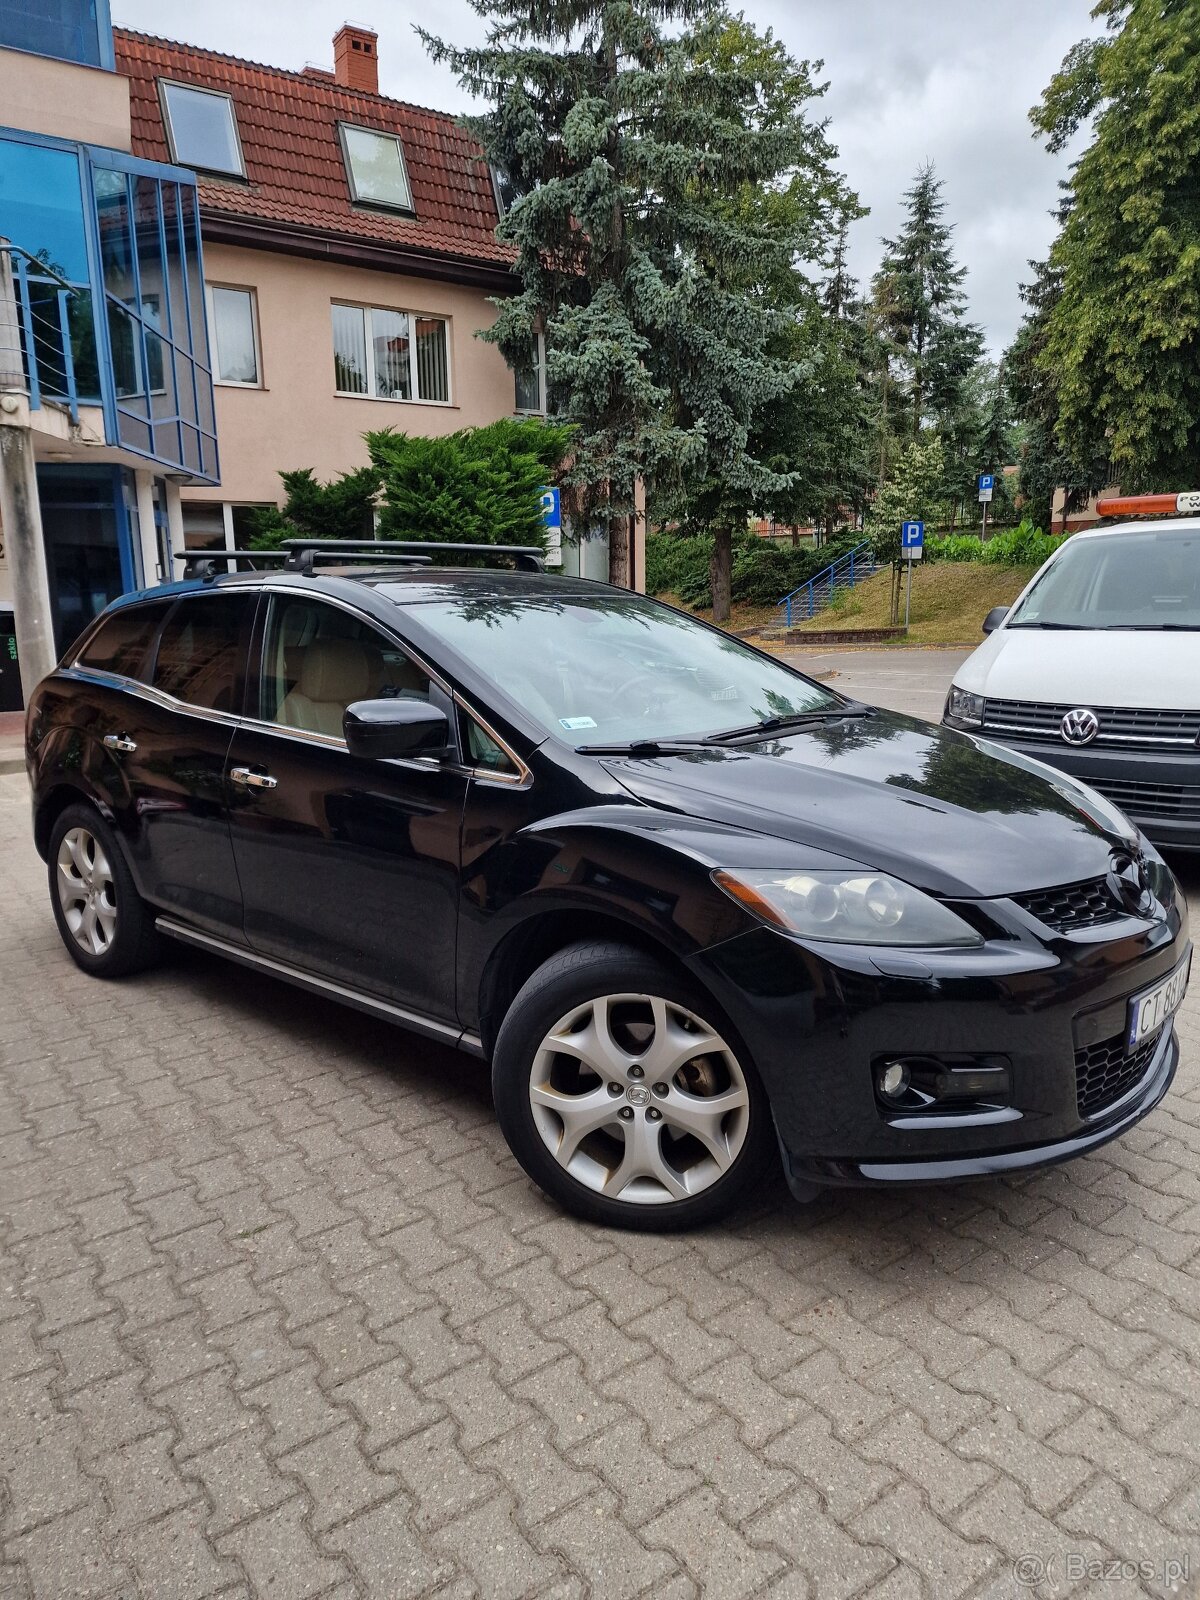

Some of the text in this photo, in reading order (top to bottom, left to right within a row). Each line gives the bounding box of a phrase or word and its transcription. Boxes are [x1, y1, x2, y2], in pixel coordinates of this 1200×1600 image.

[982, 476, 991, 487] P
[907, 524, 920, 544] P
[1061, 709, 1098, 745] VW
[1141, 990, 1162, 1034] CT
